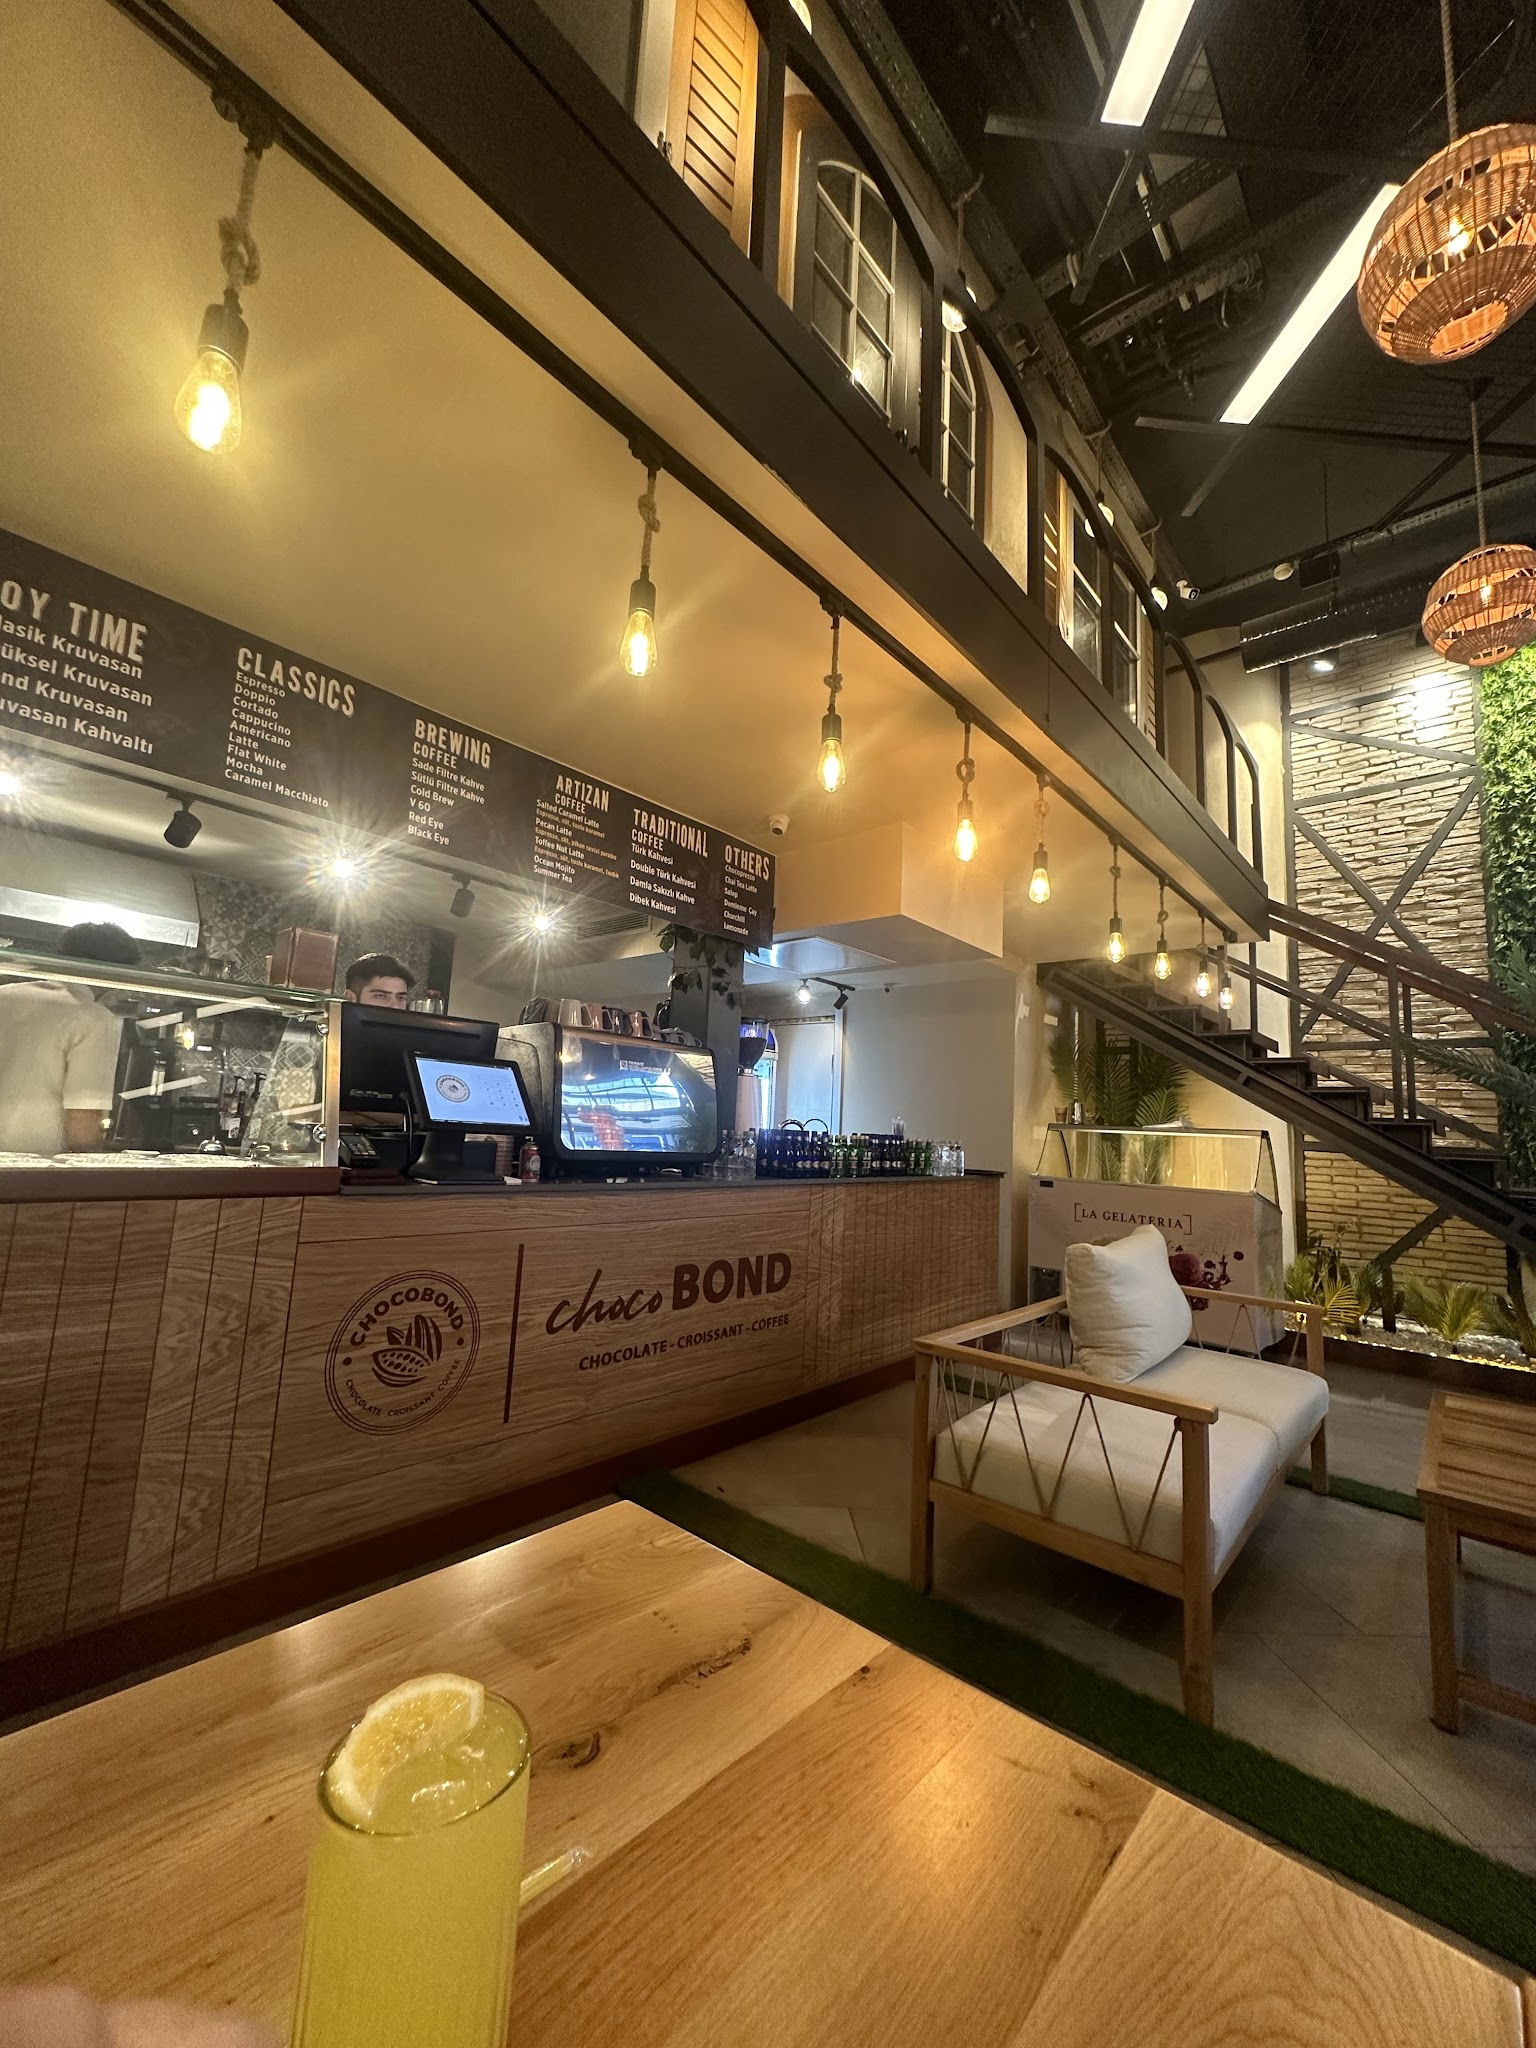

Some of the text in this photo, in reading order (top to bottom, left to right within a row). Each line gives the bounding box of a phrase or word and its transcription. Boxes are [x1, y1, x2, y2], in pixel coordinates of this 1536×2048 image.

[1, 580, 148, 663] OY TIME
[52, 634, 143, 680] Kruvasan
[0, 645, 153, 707] üksel Kruvasan
[237, 671, 286, 698] Espresso
[238, 647, 356, 718] CLASSICS
[35, 680, 128, 723] Kruvasan
[233, 696, 279, 720] Cortado
[235, 684, 276, 706] Doppio
[73, 717, 153, 755] Kahvaltı
[230, 720, 291, 748] Americano
[232, 708, 291, 736] Cappucino
[229, 731, 259, 749] Latte
[415, 718, 491, 769] BREWING
[226, 755, 264, 776] Mocha
[228, 743, 287, 771] Flat White
[414, 741, 458, 769] COFFEE
[225, 768, 329, 808] Caramel Macchiato
[412, 770, 485, 804] Sütlü Filtre Kahve
[413, 757, 485, 791] Sade Filtre Kahve
[410, 797, 431, 812] V 60
[411, 784, 455, 807] Cold Brew
[555, 793, 587, 814] COFFEE
[556, 775, 610, 812] ARTIZAN
[409, 811, 444, 830] Red Eye
[536, 818, 573, 837] Pecan Latte
[537, 799, 600, 829] Salted Caramel Latte
[408, 825, 450, 845] Black Eye
[632, 828, 664, 851] COFFEE
[634, 808, 708, 858] TRADITIONAL
[535, 836, 585, 860] Toffee Nut Latte
[632, 843, 674, 866] Türk Kahvesi
[533, 864, 573, 884] Summer Tea
[535, 855, 576, 875] Ocean Mojito
[631, 859, 697, 890] Double Türk Kahvesi
[725, 845, 770, 881] OTHERS
[630, 875, 652, 891] Damla
[676, 891, 696, 905] Kahve
[745, 883, 758, 894] Latte
[629, 892, 677, 915] Dibek Kahvesi
[1082, 1208, 1183, 1230] LA GELATERIA
[546, 1253, 792, 1335] choco BOND
[351, 1287, 464, 1346] CHOCOBOND
[579, 1314, 790, 1371] CHOCOLATE CROISSANT COFFEE
[346, 1378, 383, 1416] CHOCOLATE
[388, 1392, 437, 1417] CROISSANT
